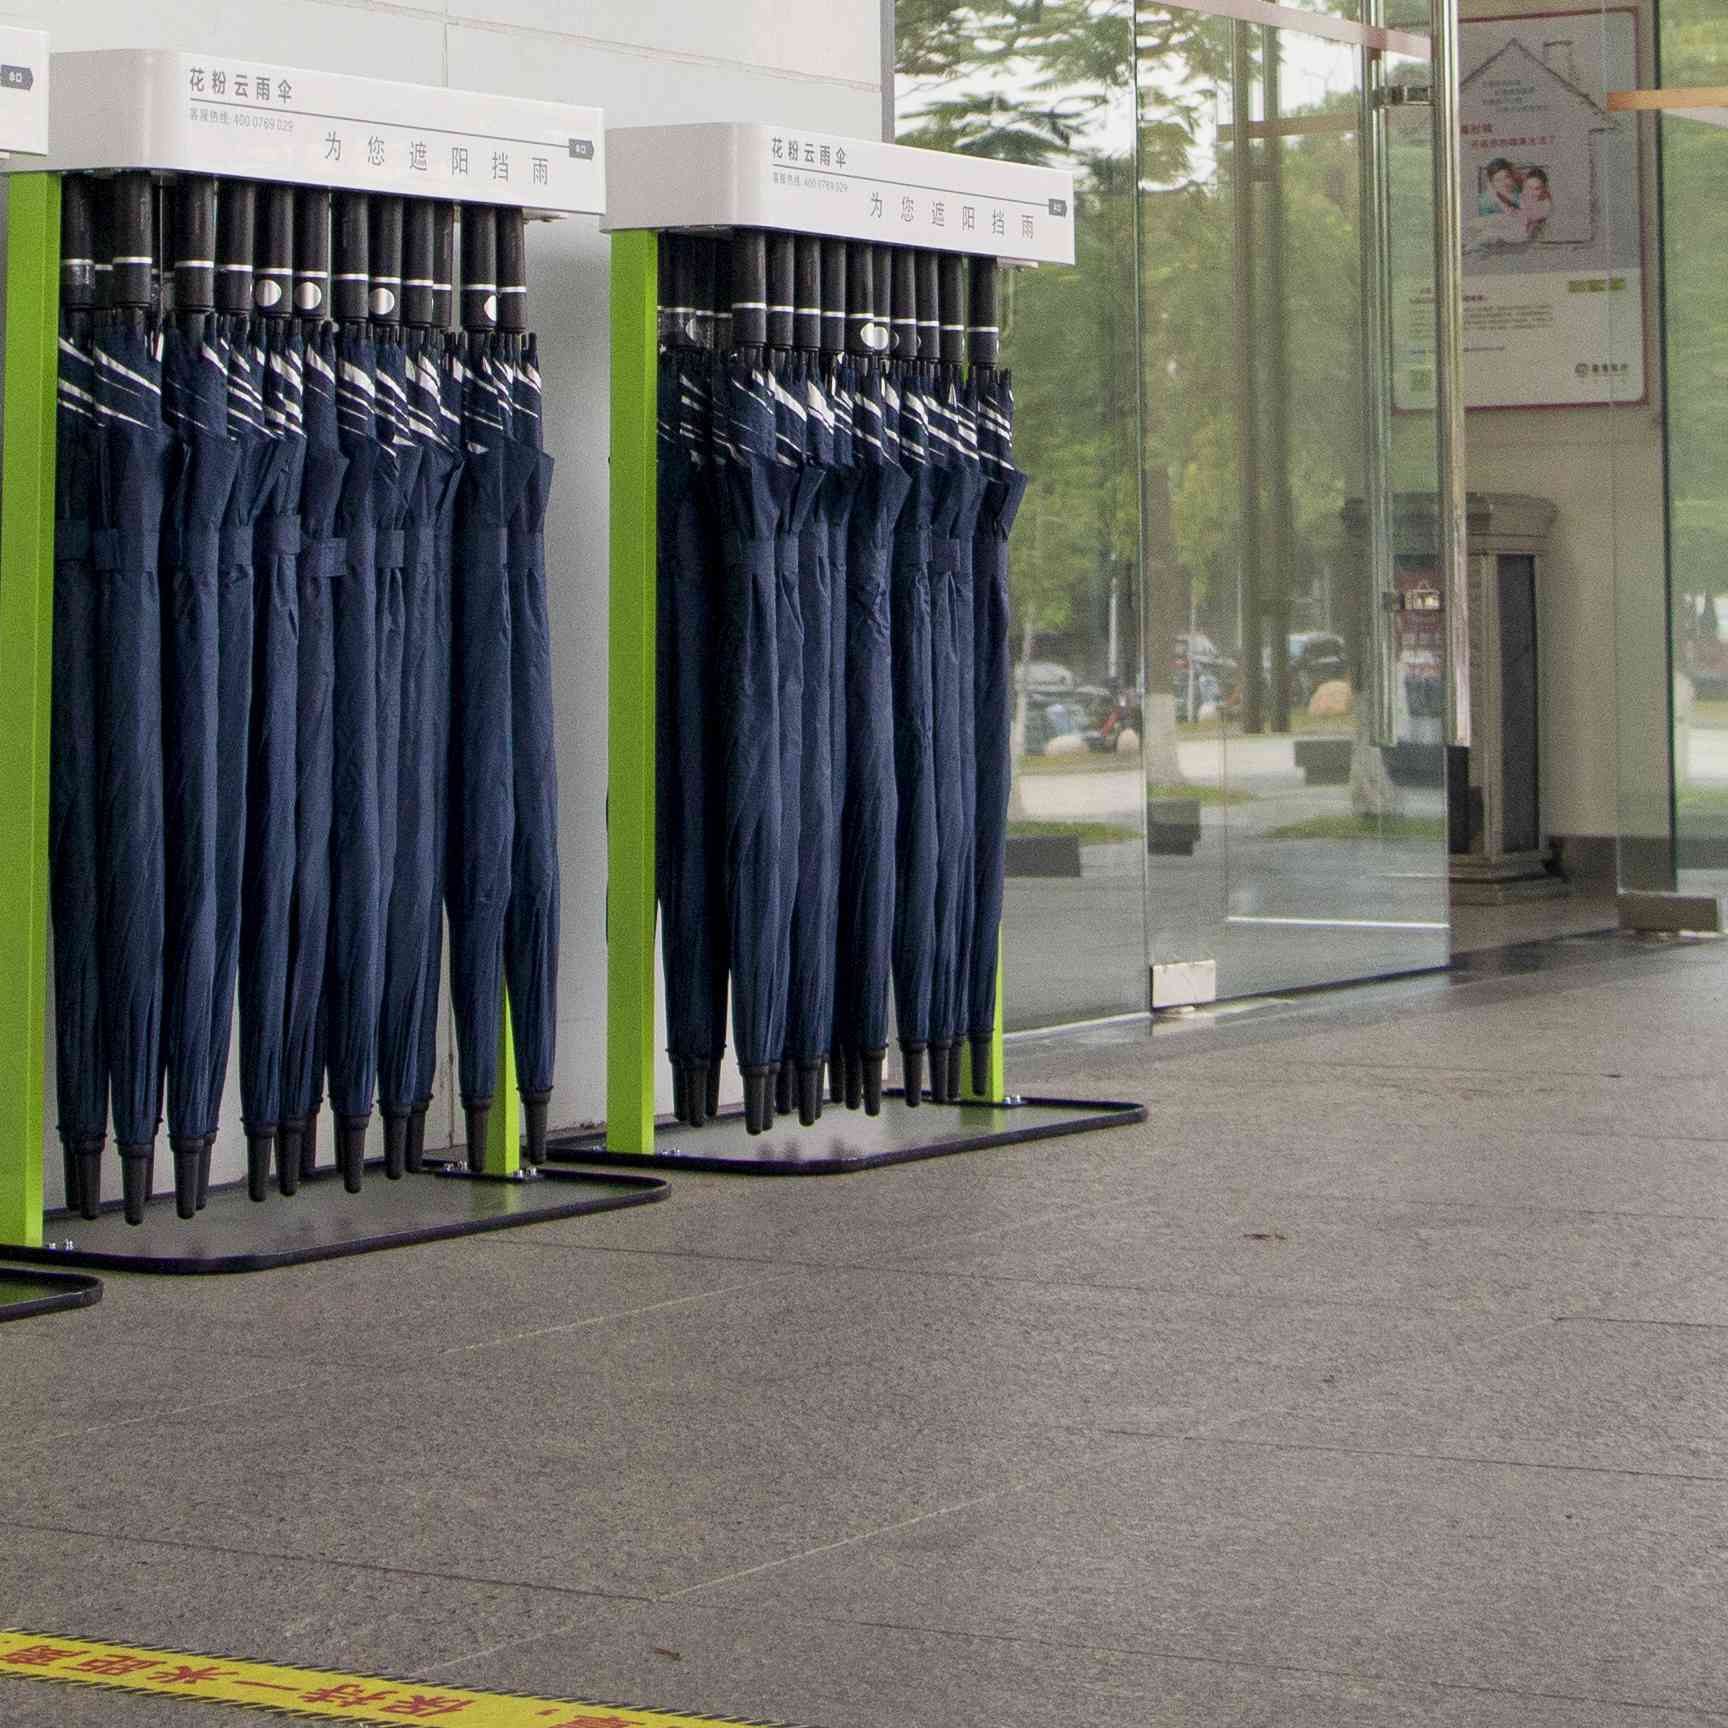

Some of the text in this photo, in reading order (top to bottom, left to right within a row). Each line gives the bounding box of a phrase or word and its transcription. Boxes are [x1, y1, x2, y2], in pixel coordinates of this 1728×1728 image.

[189, 67, 293, 104] 花粉云雨伞
[324, 131, 549, 186] 为您遮阳挡雨
[771, 136, 847, 168] 花粉云雨伞
[870, 191, 1035, 239] 为您遮阳挡雨
